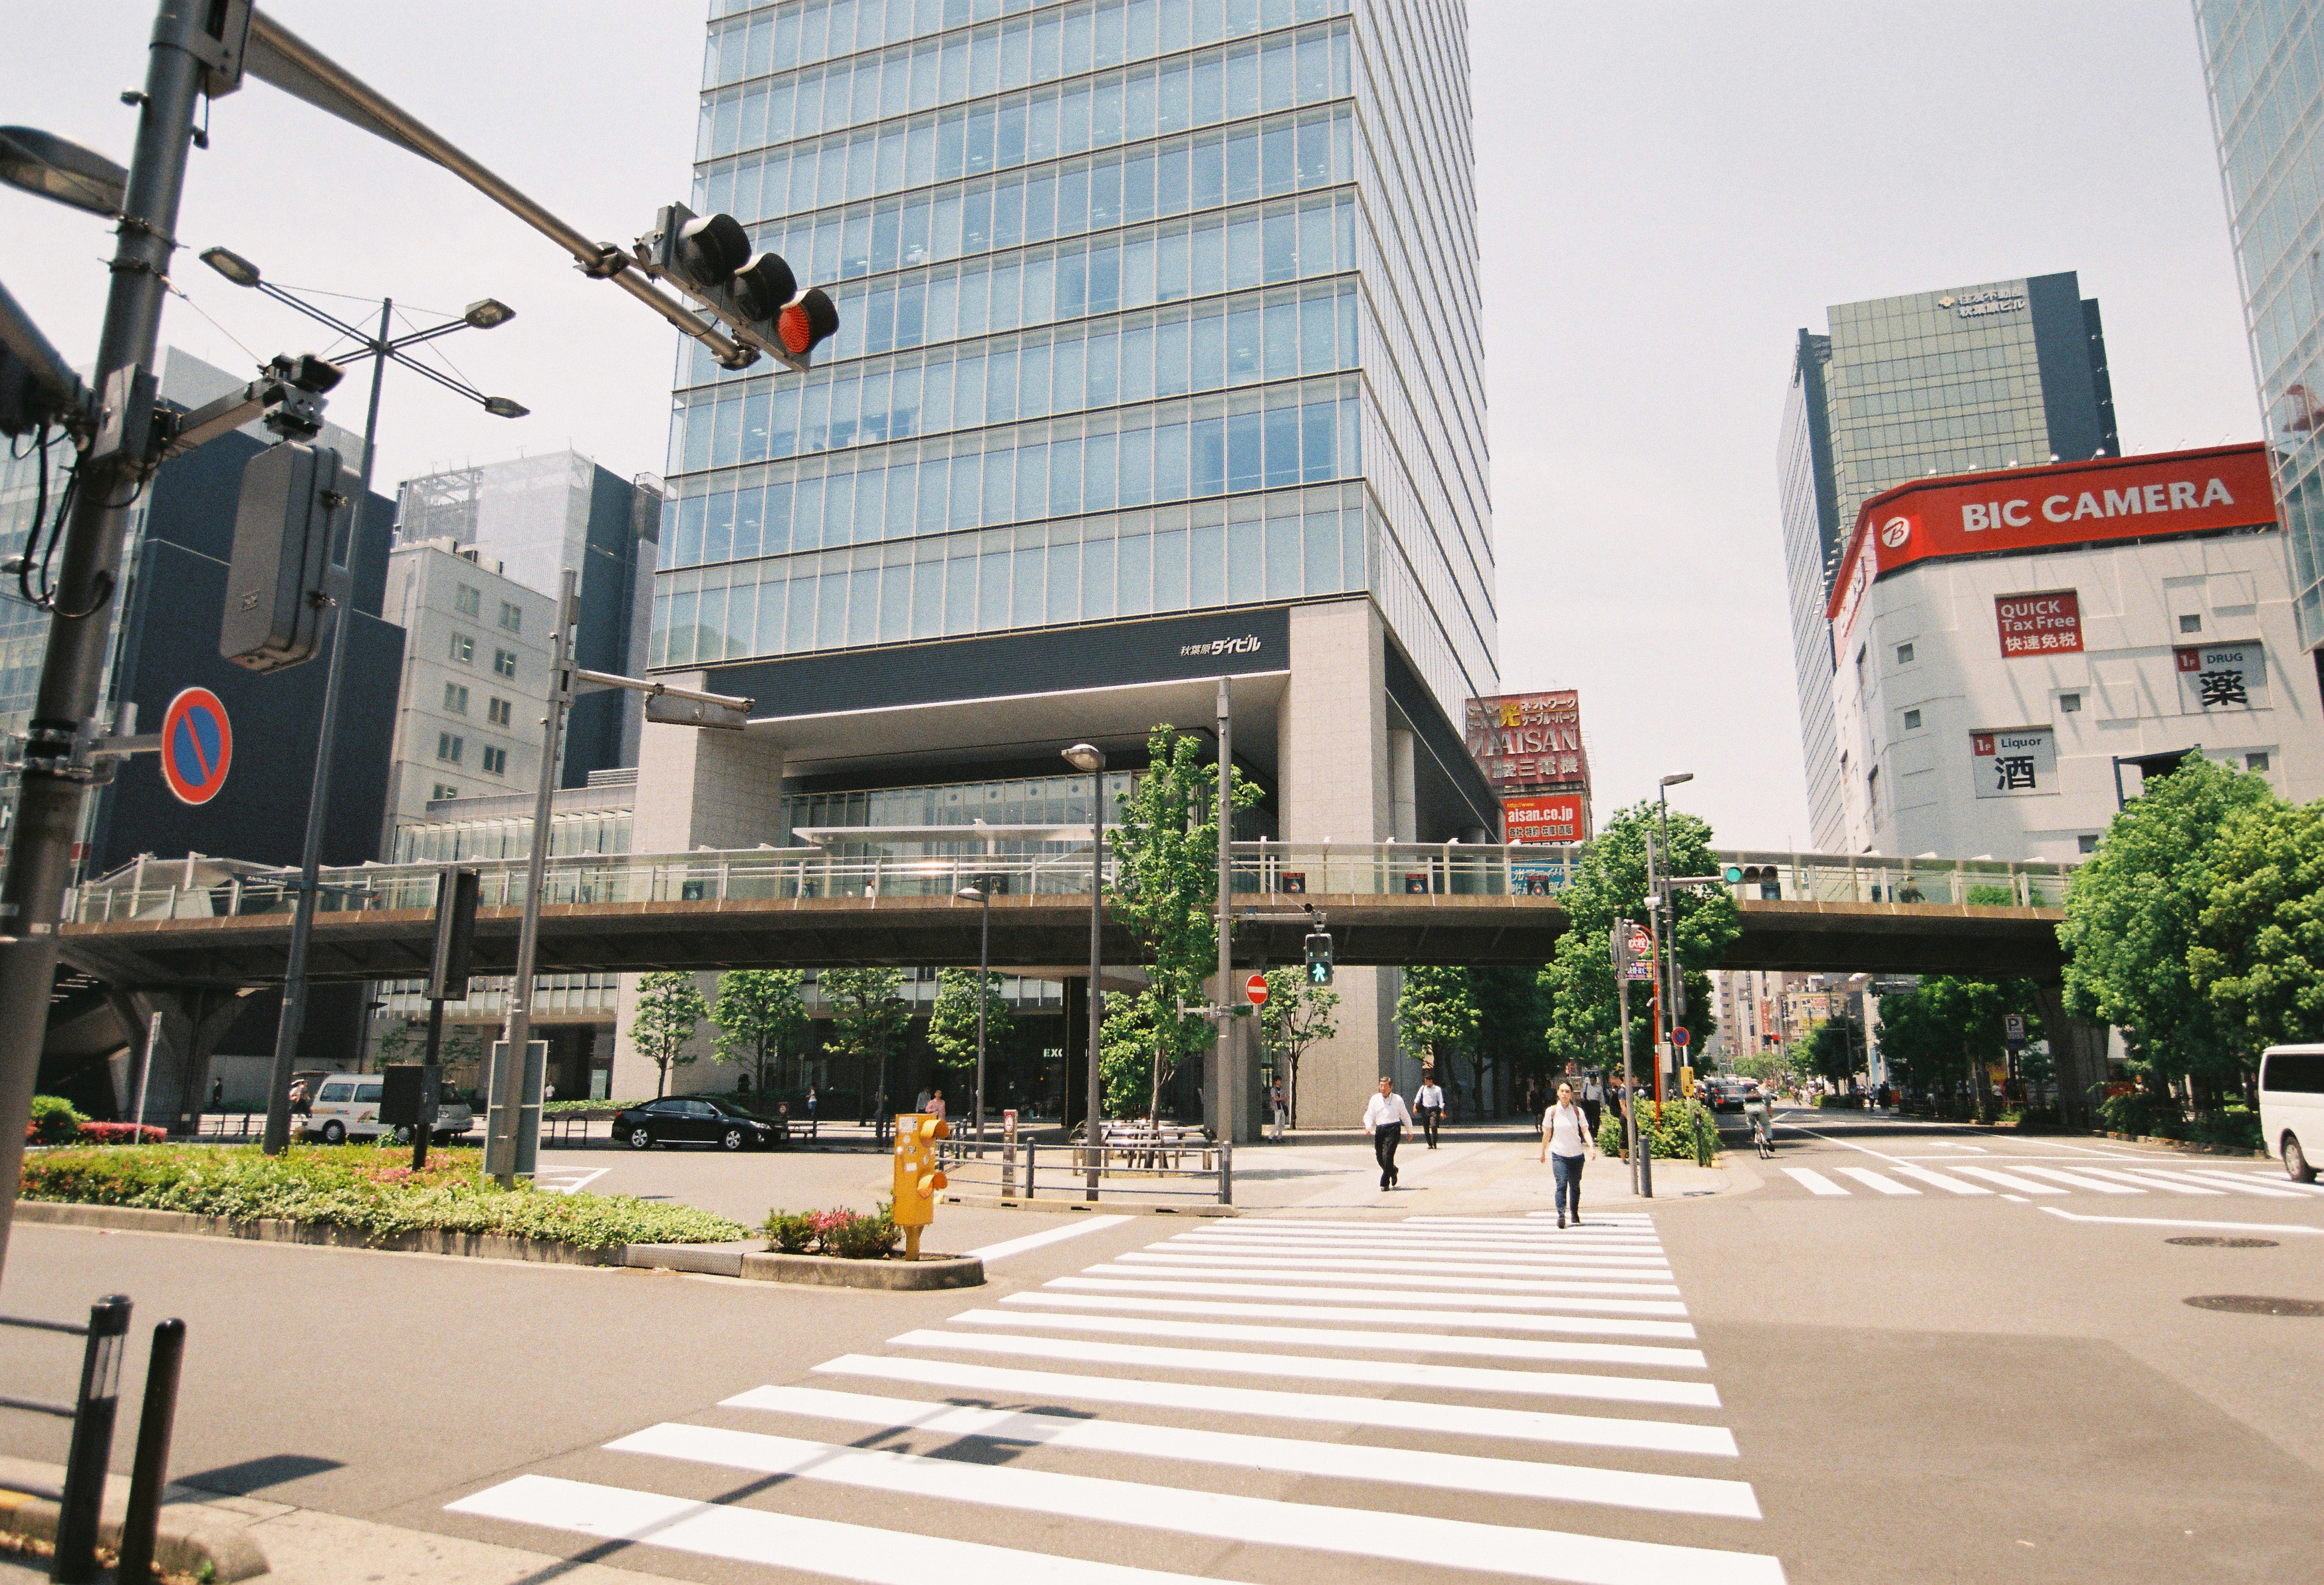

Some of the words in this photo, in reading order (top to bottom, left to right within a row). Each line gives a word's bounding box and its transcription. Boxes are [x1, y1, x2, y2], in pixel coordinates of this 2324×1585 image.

[1962, 498, 2032, 532] BIC
[2041, 478, 2234, 523] CAMERA
[2000, 600, 2061, 619] QUICK
[2002, 619, 2034, 632] Tax
[2036, 615, 2075, 629] Free
[1180, 634, 1261, 657] 秋葉原ダイビル
[2005, 632, 2077, 651] 快速免税
[2180, 654, 2195, 669] 1F
[2206, 653, 2244, 665] DRUG
[2198, 670, 2248, 706] 薬
[1500, 702, 1521, 727] 光
[1976, 738, 1992, 752] 1F
[2001, 736, 2042, 750] Liquor
[1994, 756, 2036, 790] 酒
[1508, 806, 1573, 823] aisan.co.jp
[1509, 827, 1524, 838] 各社
[1542, 825, 1556, 837] 在庫
